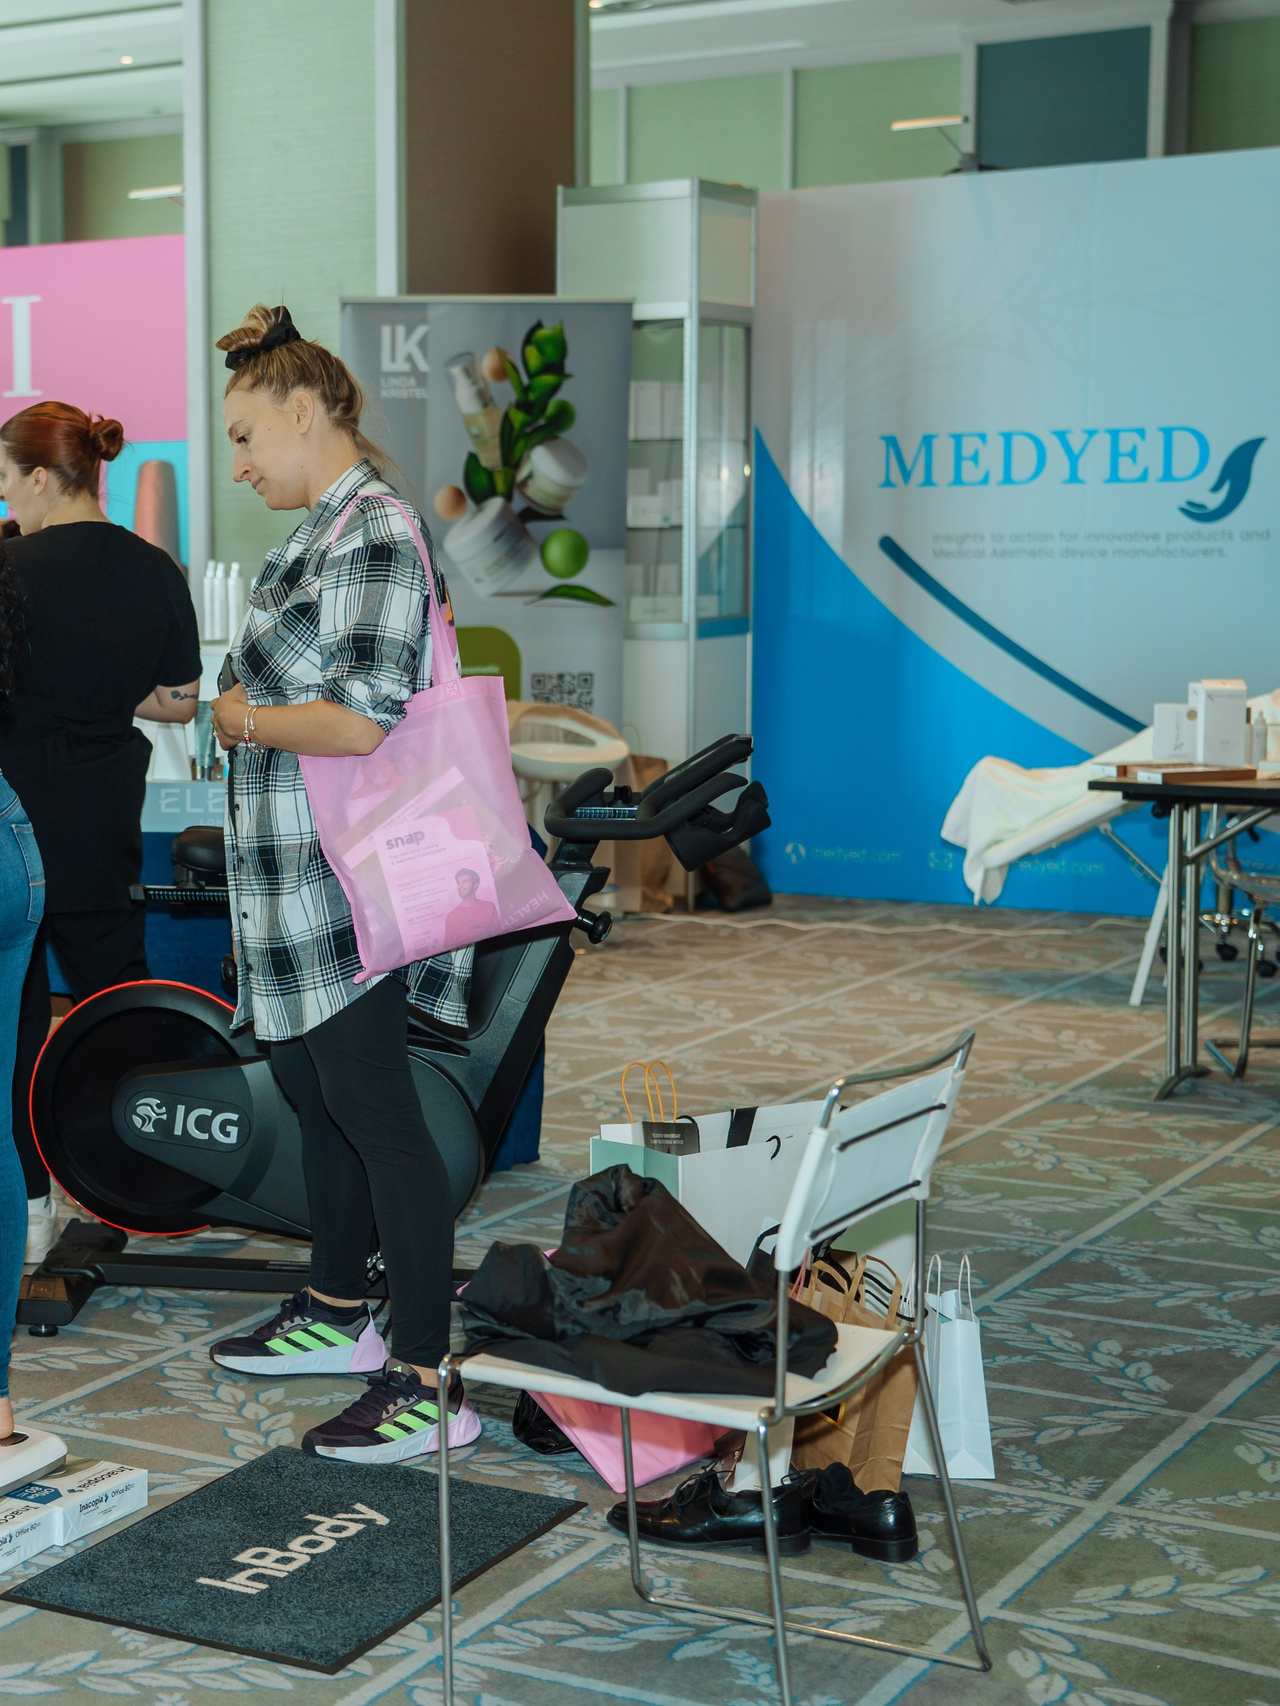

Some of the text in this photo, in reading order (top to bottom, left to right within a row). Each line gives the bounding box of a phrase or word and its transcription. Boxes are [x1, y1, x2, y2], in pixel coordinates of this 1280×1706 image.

[381, 325, 430, 373] LK
[877, 426, 1211, 488] MEDYED
[1009, 531, 1055, 543] action
[1059, 529, 1079, 543] for
[1084, 530, 1160, 543] innovative
[1165, 528, 1235, 543] products
[1240, 528, 1271, 542] and
[932, 547, 985, 560] Medical
[1059, 546, 1108, 560] device
[385, 830, 425, 850] snap
[173, 1104, 240, 1144] ICG
[79, 1495, 104, 1514] Inacopia
[111, 1487, 126, 1499] Office
[15, 1527, 30, 1539] Office
[196, 1502, 390, 1594] InBody
